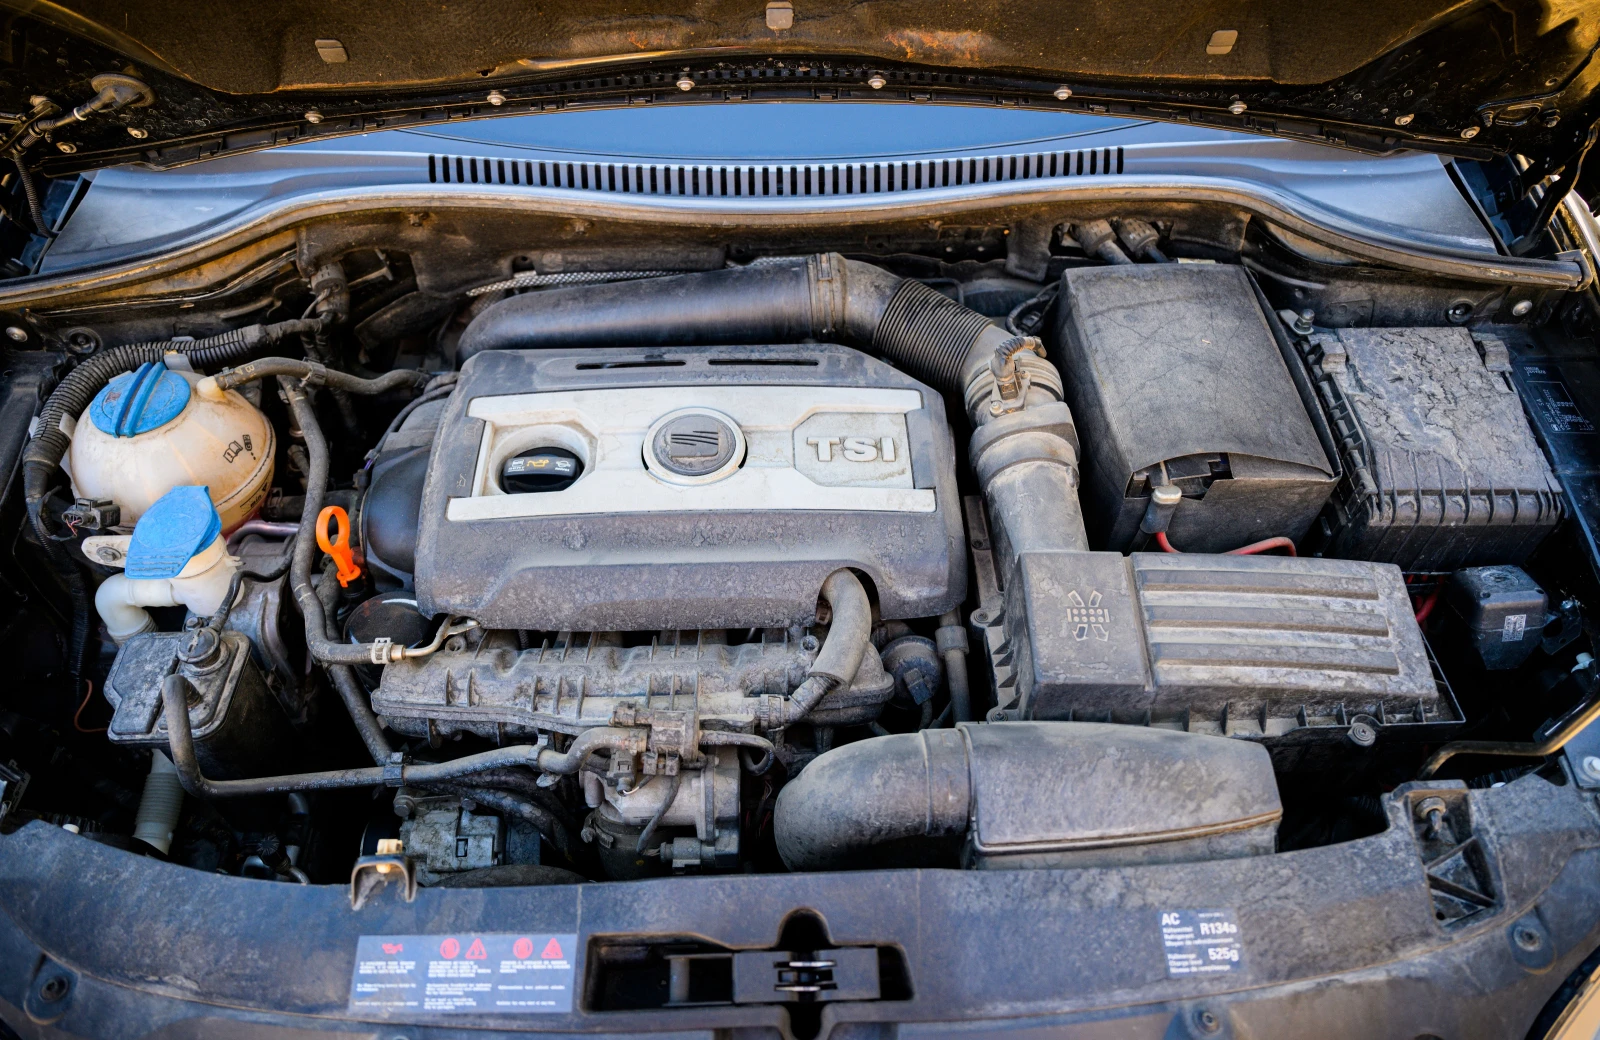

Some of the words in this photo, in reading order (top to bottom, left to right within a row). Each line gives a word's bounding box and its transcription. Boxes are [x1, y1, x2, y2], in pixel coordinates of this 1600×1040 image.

[807, 437, 897, 462] TSI
[250, 494, 262, 508] min
[1161, 912, 1180, 926] AC
[1200, 922, 1237, 935] R134a
[1207, 947, 1239, 962] 525g
